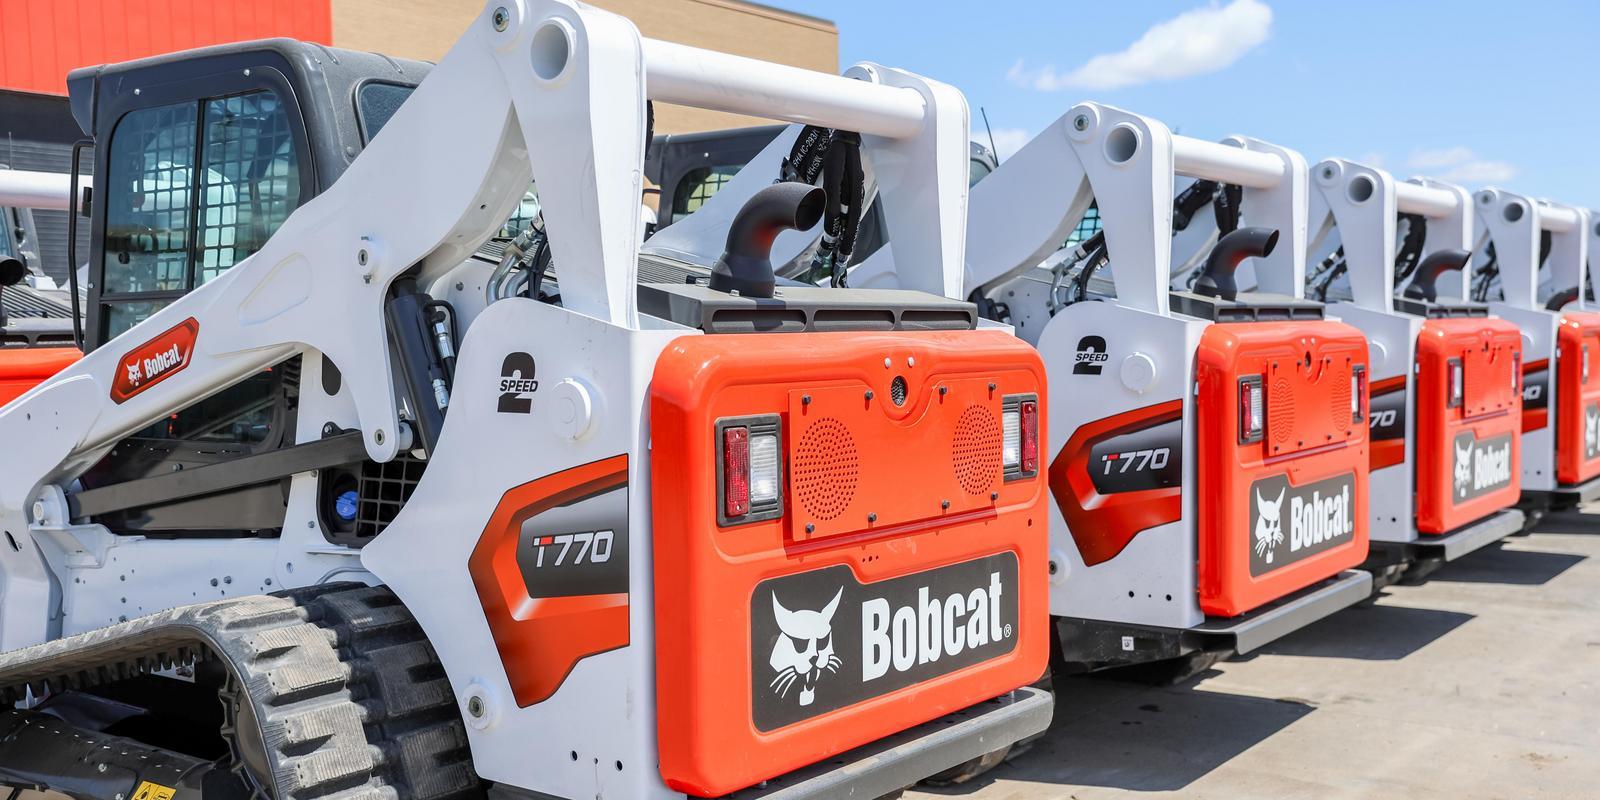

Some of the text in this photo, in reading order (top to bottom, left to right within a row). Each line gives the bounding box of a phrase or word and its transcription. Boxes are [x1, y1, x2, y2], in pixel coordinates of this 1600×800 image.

[143, 343, 181, 378] Bobcat
[1072, 335, 1109, 375] 2 SPEED
[497, 351, 539, 414] 2 SPEED
[1101, 447, 1170, 475] T770
[1474, 441, 1510, 490] Bobcat
[1290, 484, 1350, 552] Bobcat
[533, 529, 614, 568] T770
